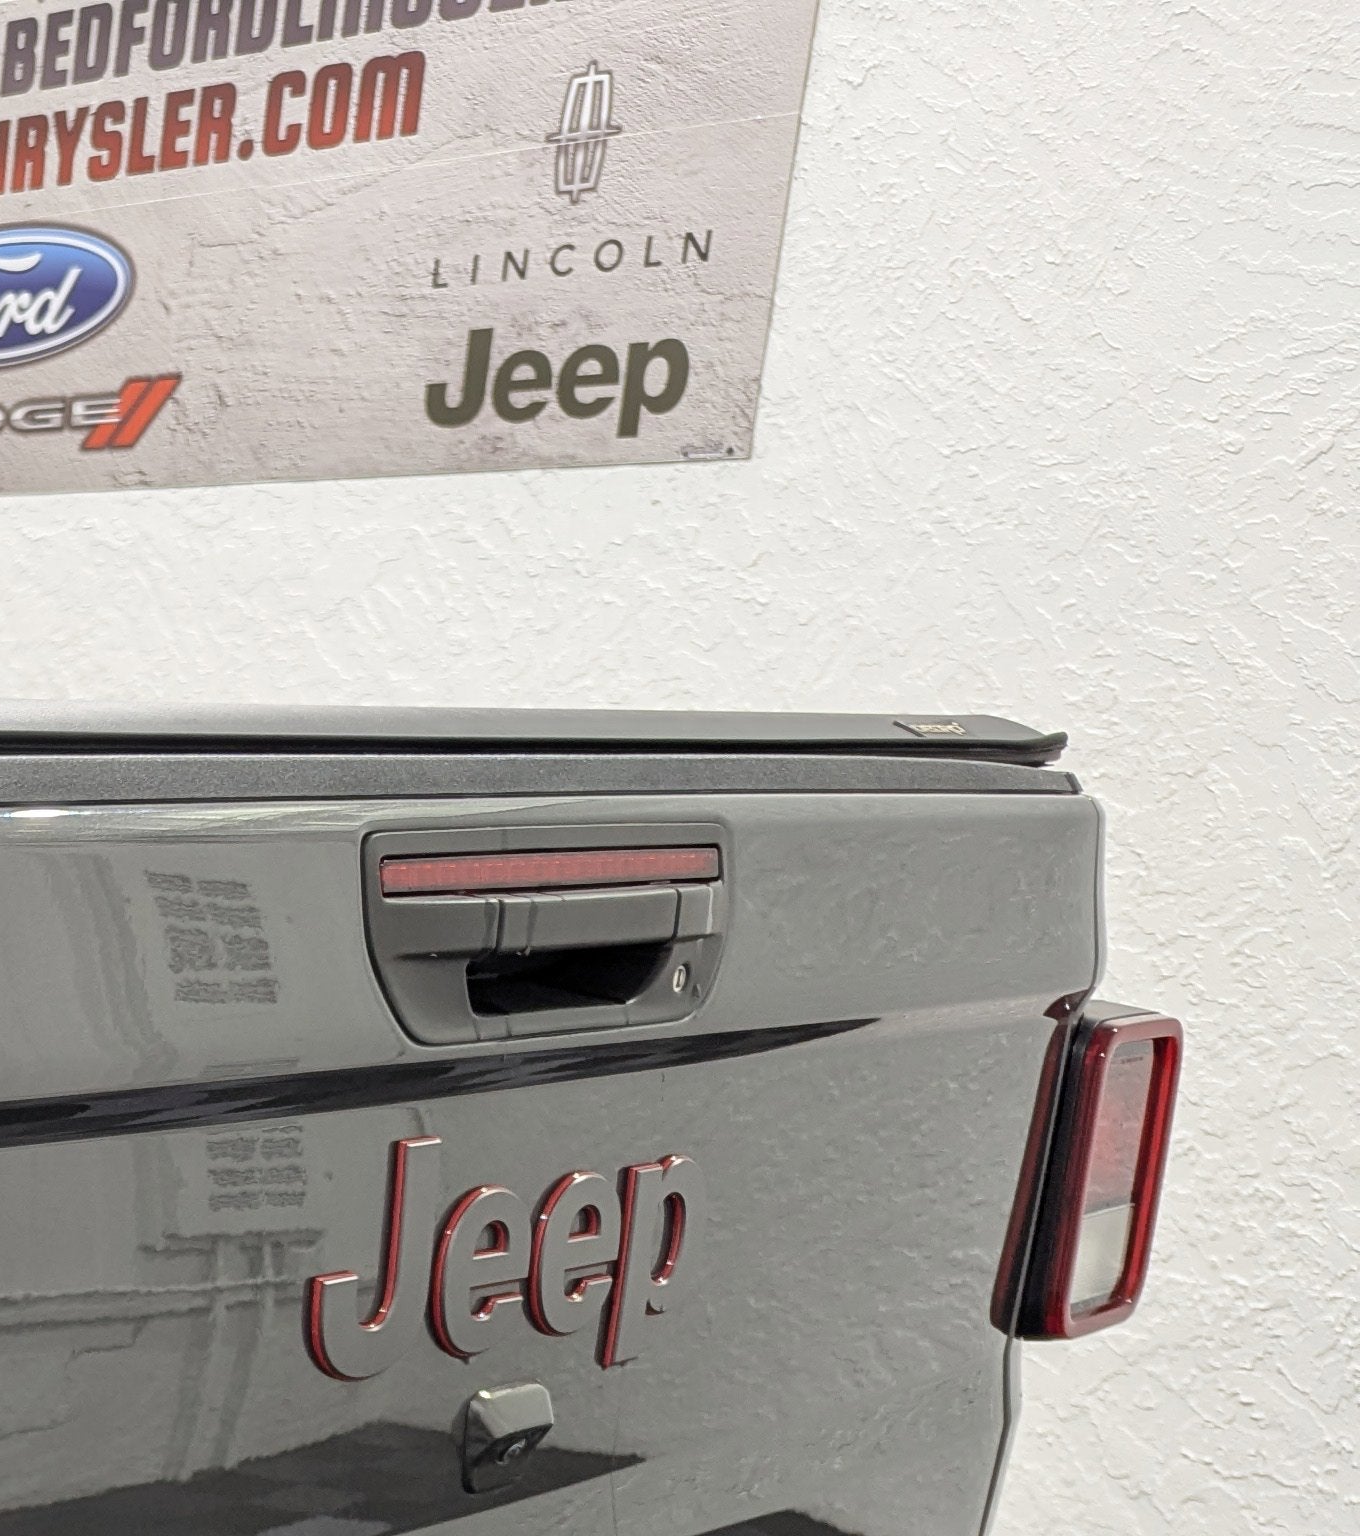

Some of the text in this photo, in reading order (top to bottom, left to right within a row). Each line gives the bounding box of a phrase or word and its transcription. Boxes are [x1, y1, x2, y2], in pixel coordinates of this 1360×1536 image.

[430, 229, 714, 290] LINCOLN
[424, 327, 690, 438] Jeep
[301, 1134, 704, 1382] Jeep
